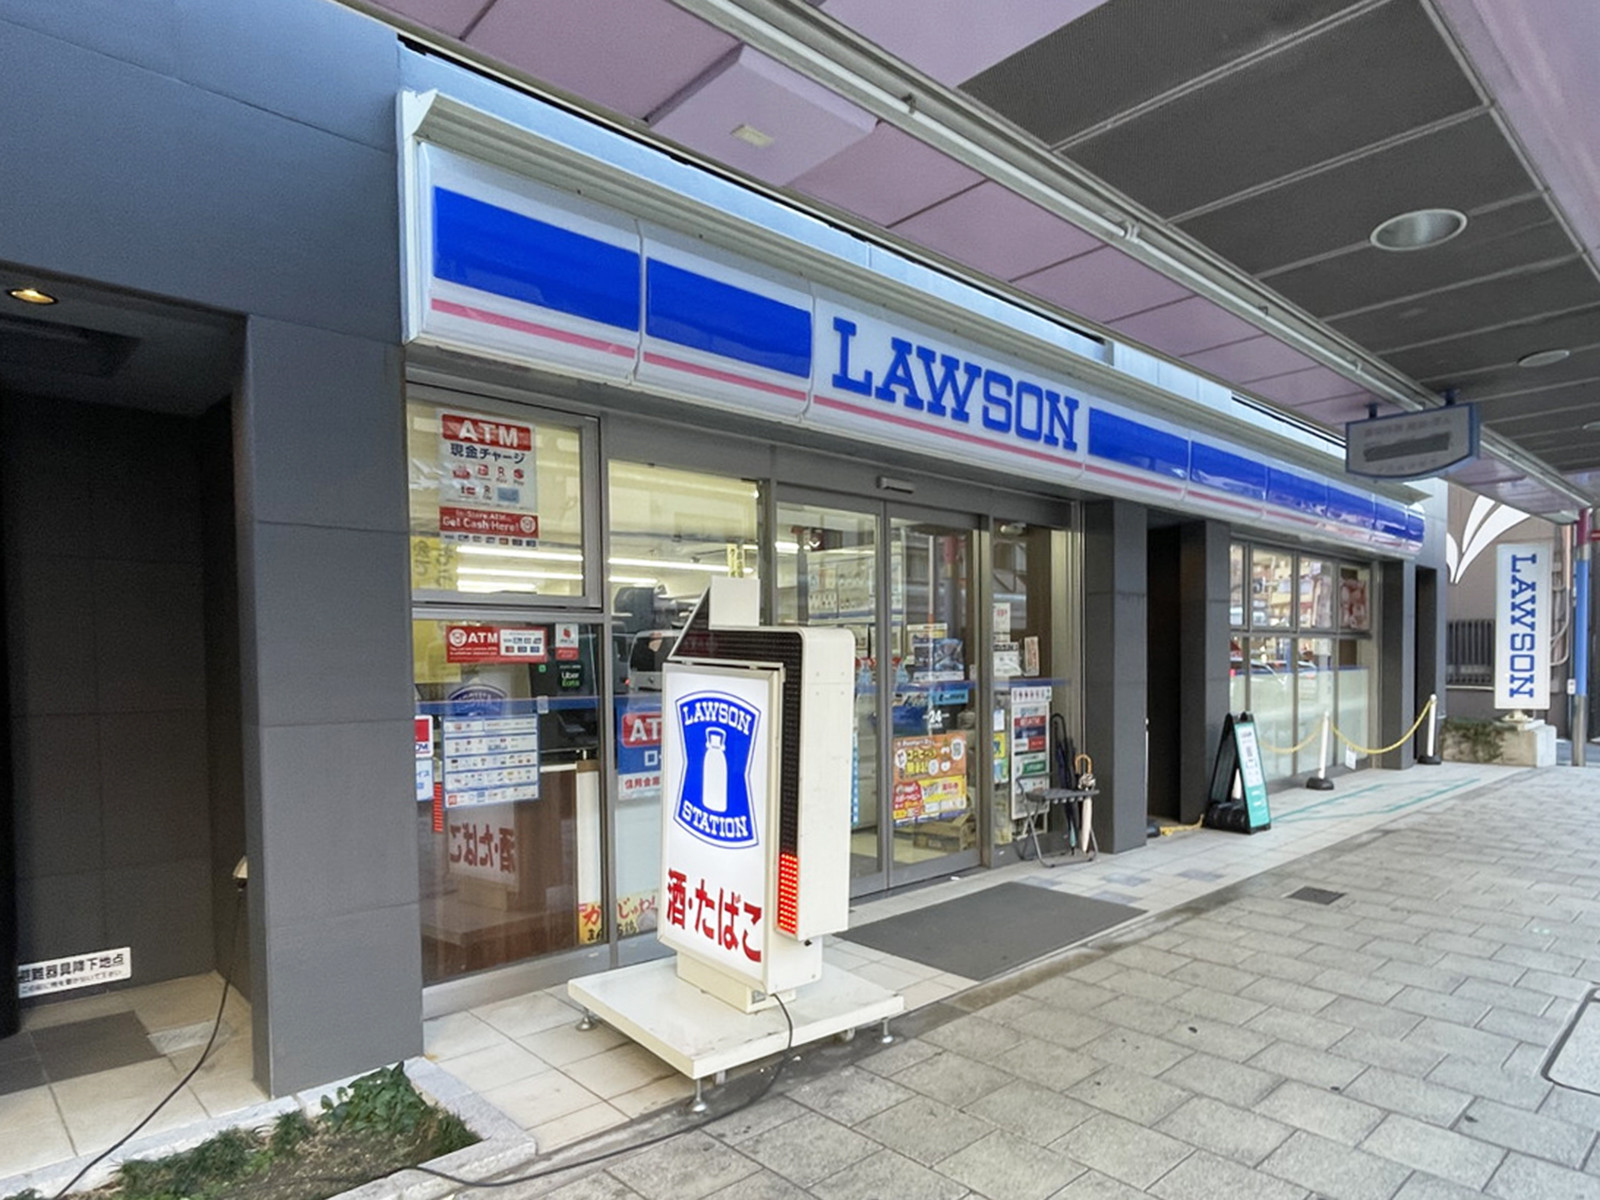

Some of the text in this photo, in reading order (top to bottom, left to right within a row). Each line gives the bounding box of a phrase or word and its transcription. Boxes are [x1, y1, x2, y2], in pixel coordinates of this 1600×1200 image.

[832, 316, 1079, 452] LAWSON
[459, 420, 519, 448] ATM
[450, 443, 526, 464] 現金チャージ
[442, 516, 461, 527] Get
[463, 518, 489, 529] Cash
[467, 632, 498, 644] ATM
[1509, 553, 1537, 698] LAWSON
[561, 671, 579, 679] Uber
[629, 718, 662, 742] AT
[683, 701, 752, 735] LAWSON
[682, 800, 748, 839] STATION
[666, 868, 762, 962] 酒・たばこ
